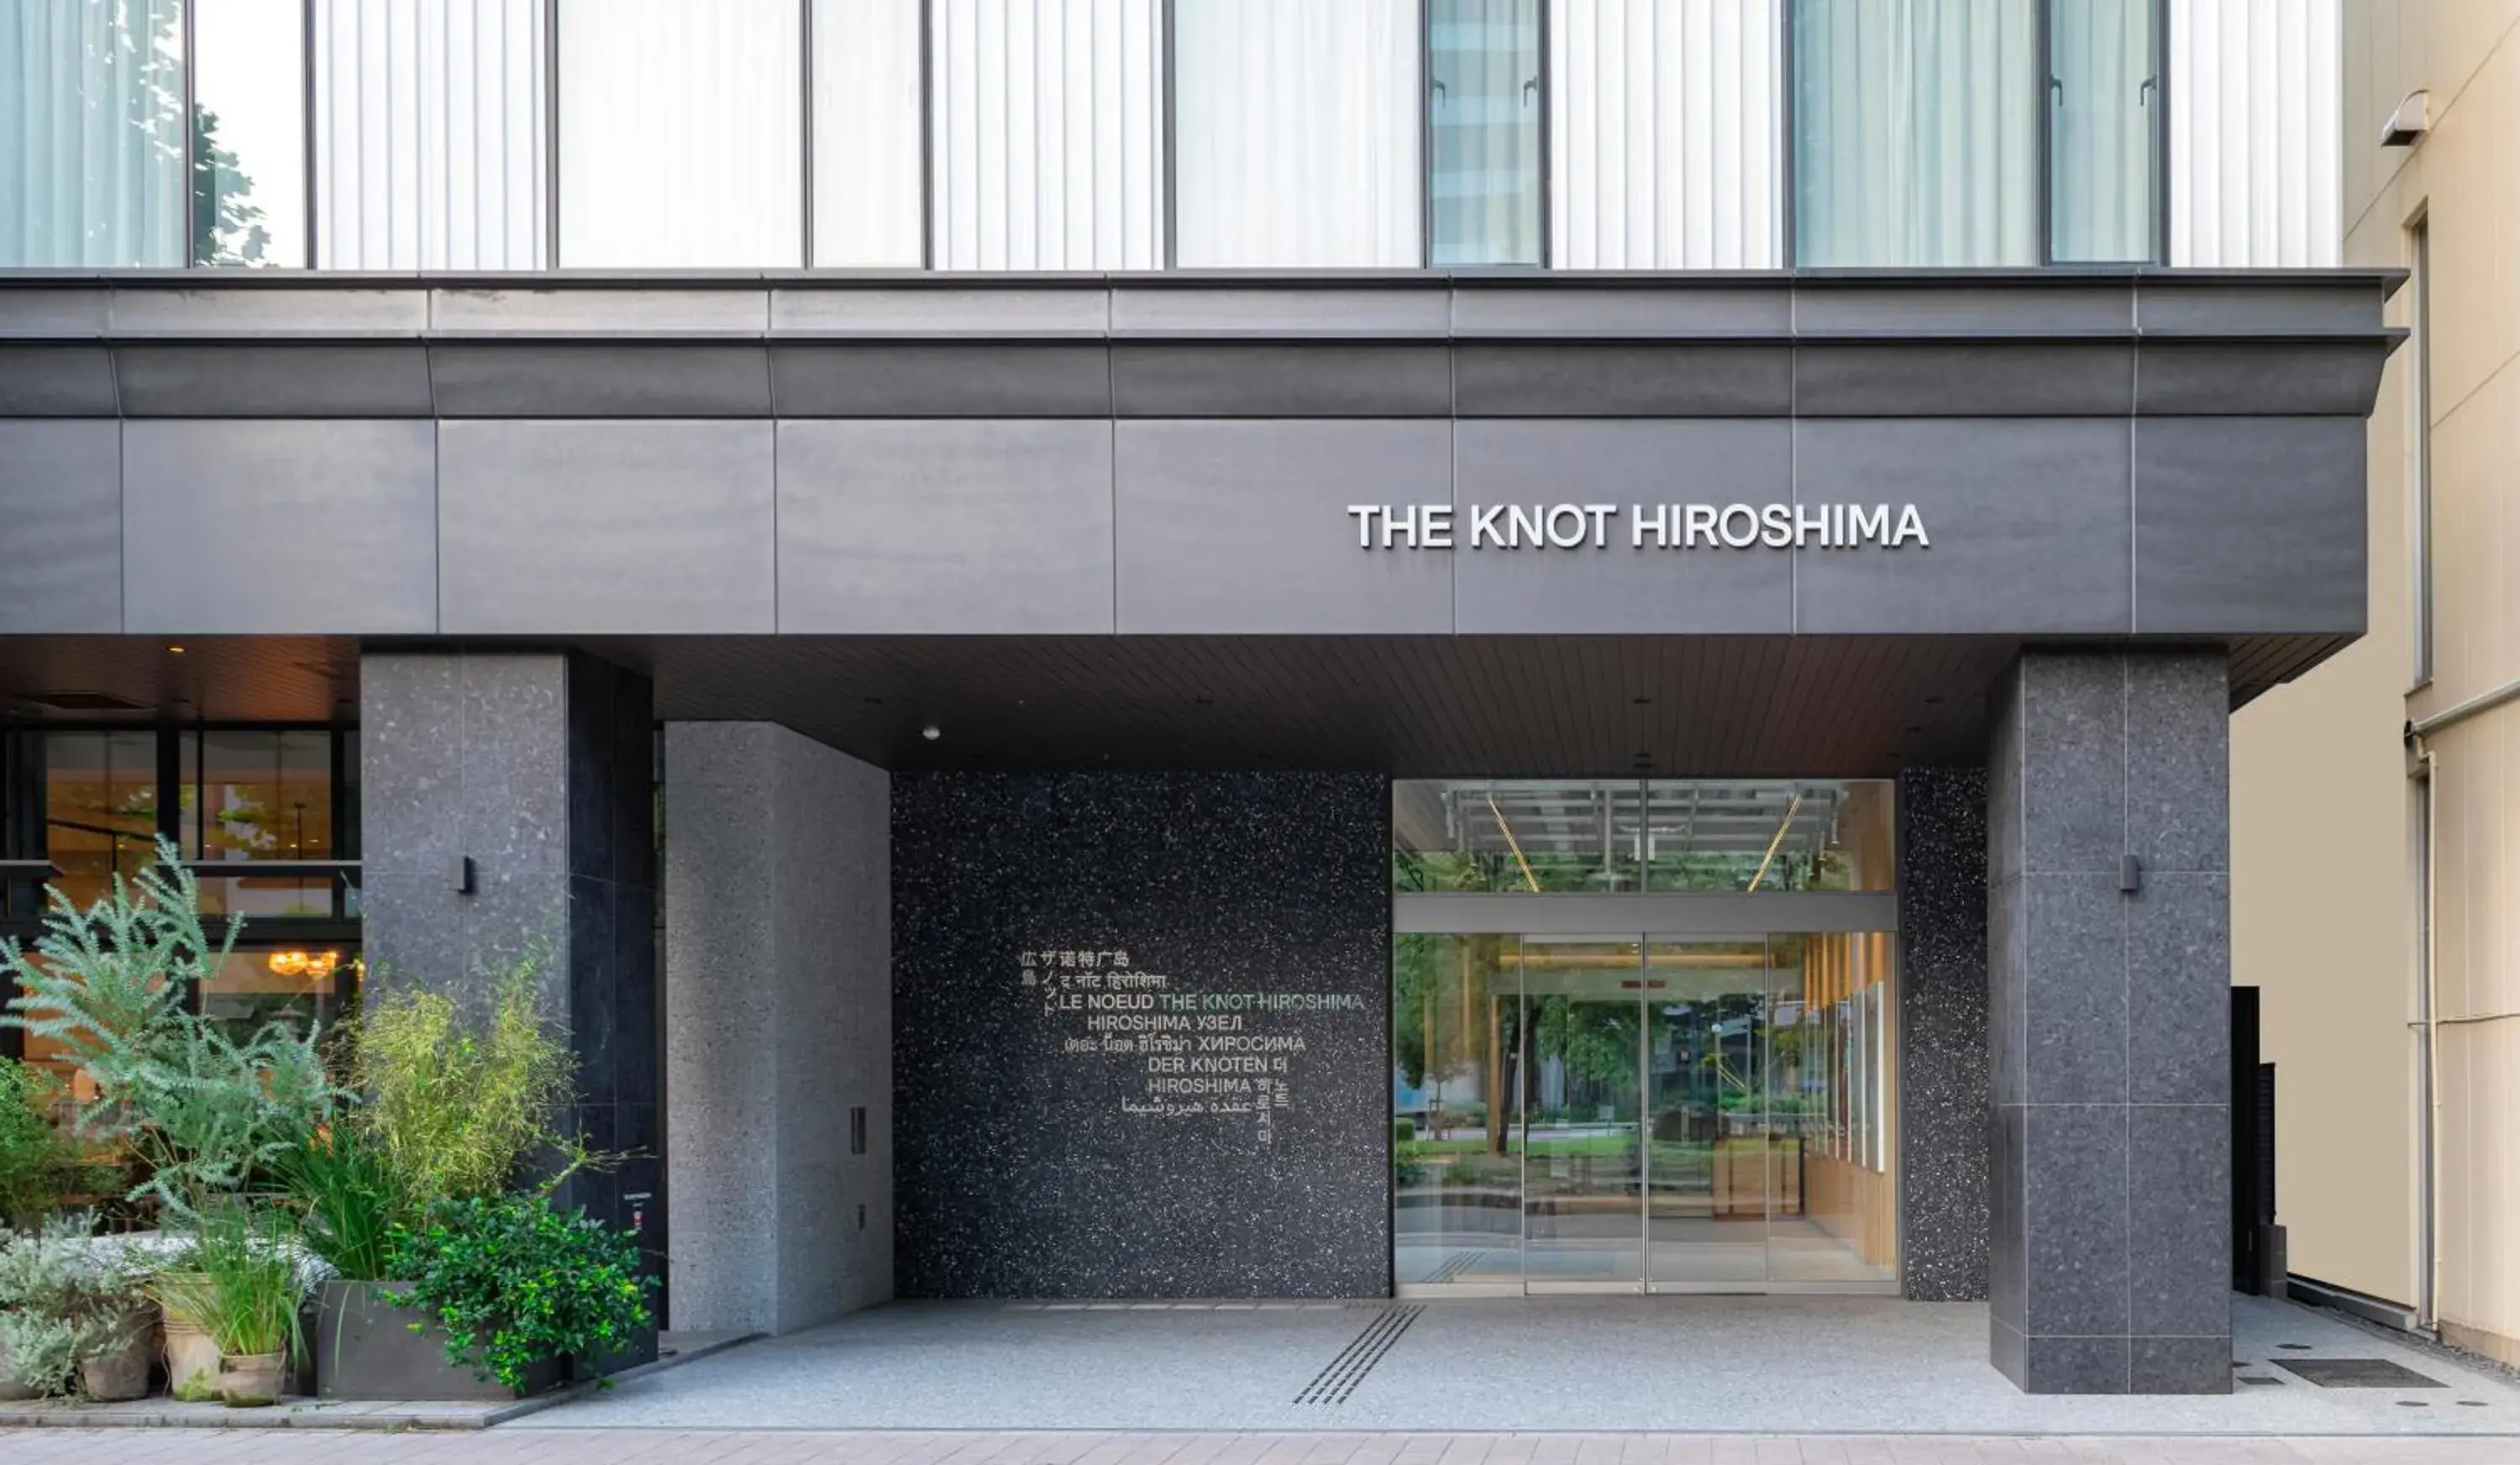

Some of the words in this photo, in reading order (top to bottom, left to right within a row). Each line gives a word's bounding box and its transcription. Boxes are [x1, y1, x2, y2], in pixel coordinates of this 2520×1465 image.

[1348, 505, 1452, 545] THE
[1472, 504, 1616, 546] KNOT
[1633, 504, 1929, 546] HIROSHIMA
[1059, 994, 1083, 1009] LE
[1088, 994, 1154, 1009] NOEUD
[1159, 994, 1197, 1009] THE
[1202, 994, 1256, 1009] KNOT
[1260, 994, 1364, 1009] HIROSHIMA
[1088, 1015, 1191, 1031] HIROSHIMA
[1196, 1015, 1242, 1031] УЗЕЛ
[1198, 1036, 1306, 1051] ХИРОСИМА
[1148, 1057, 1186, 1073] DER
[1191, 1057, 1268, 1073] KNOTEN
[1148, 1078, 1252, 1094] HIROSHIMA
